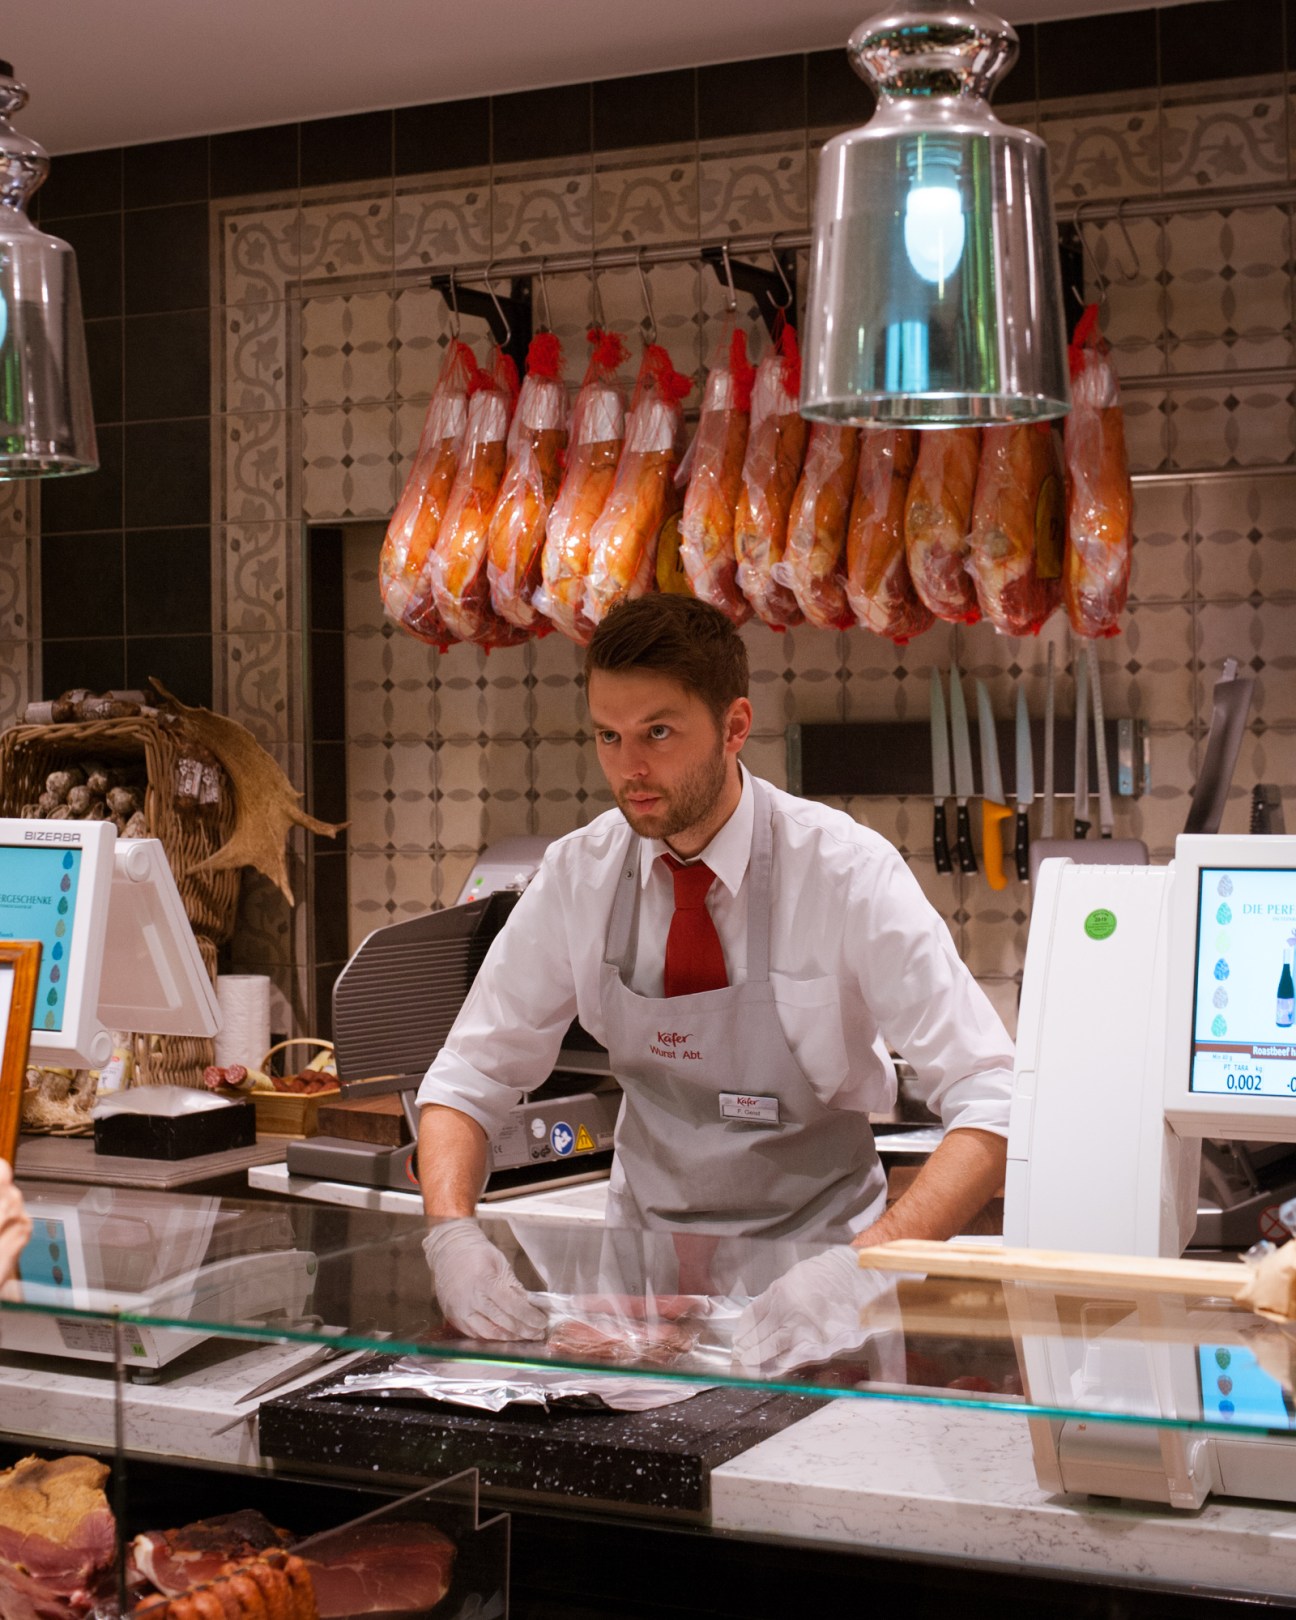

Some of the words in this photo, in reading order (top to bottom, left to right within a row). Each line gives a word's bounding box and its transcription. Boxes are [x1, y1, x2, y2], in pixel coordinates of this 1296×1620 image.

[24, 831, 81, 842] BIZERBA
[1243, 903, 1263, 914] DIE
[657, 1032, 694, 1047] Käfer
[649, 1045, 676, 1059] Wurst
[1252, 1045, 1290, 1056] Roastbeef
[1255, 1065, 1263, 1073] kg
[1226, 1074, 1262, 1092] 0,002
